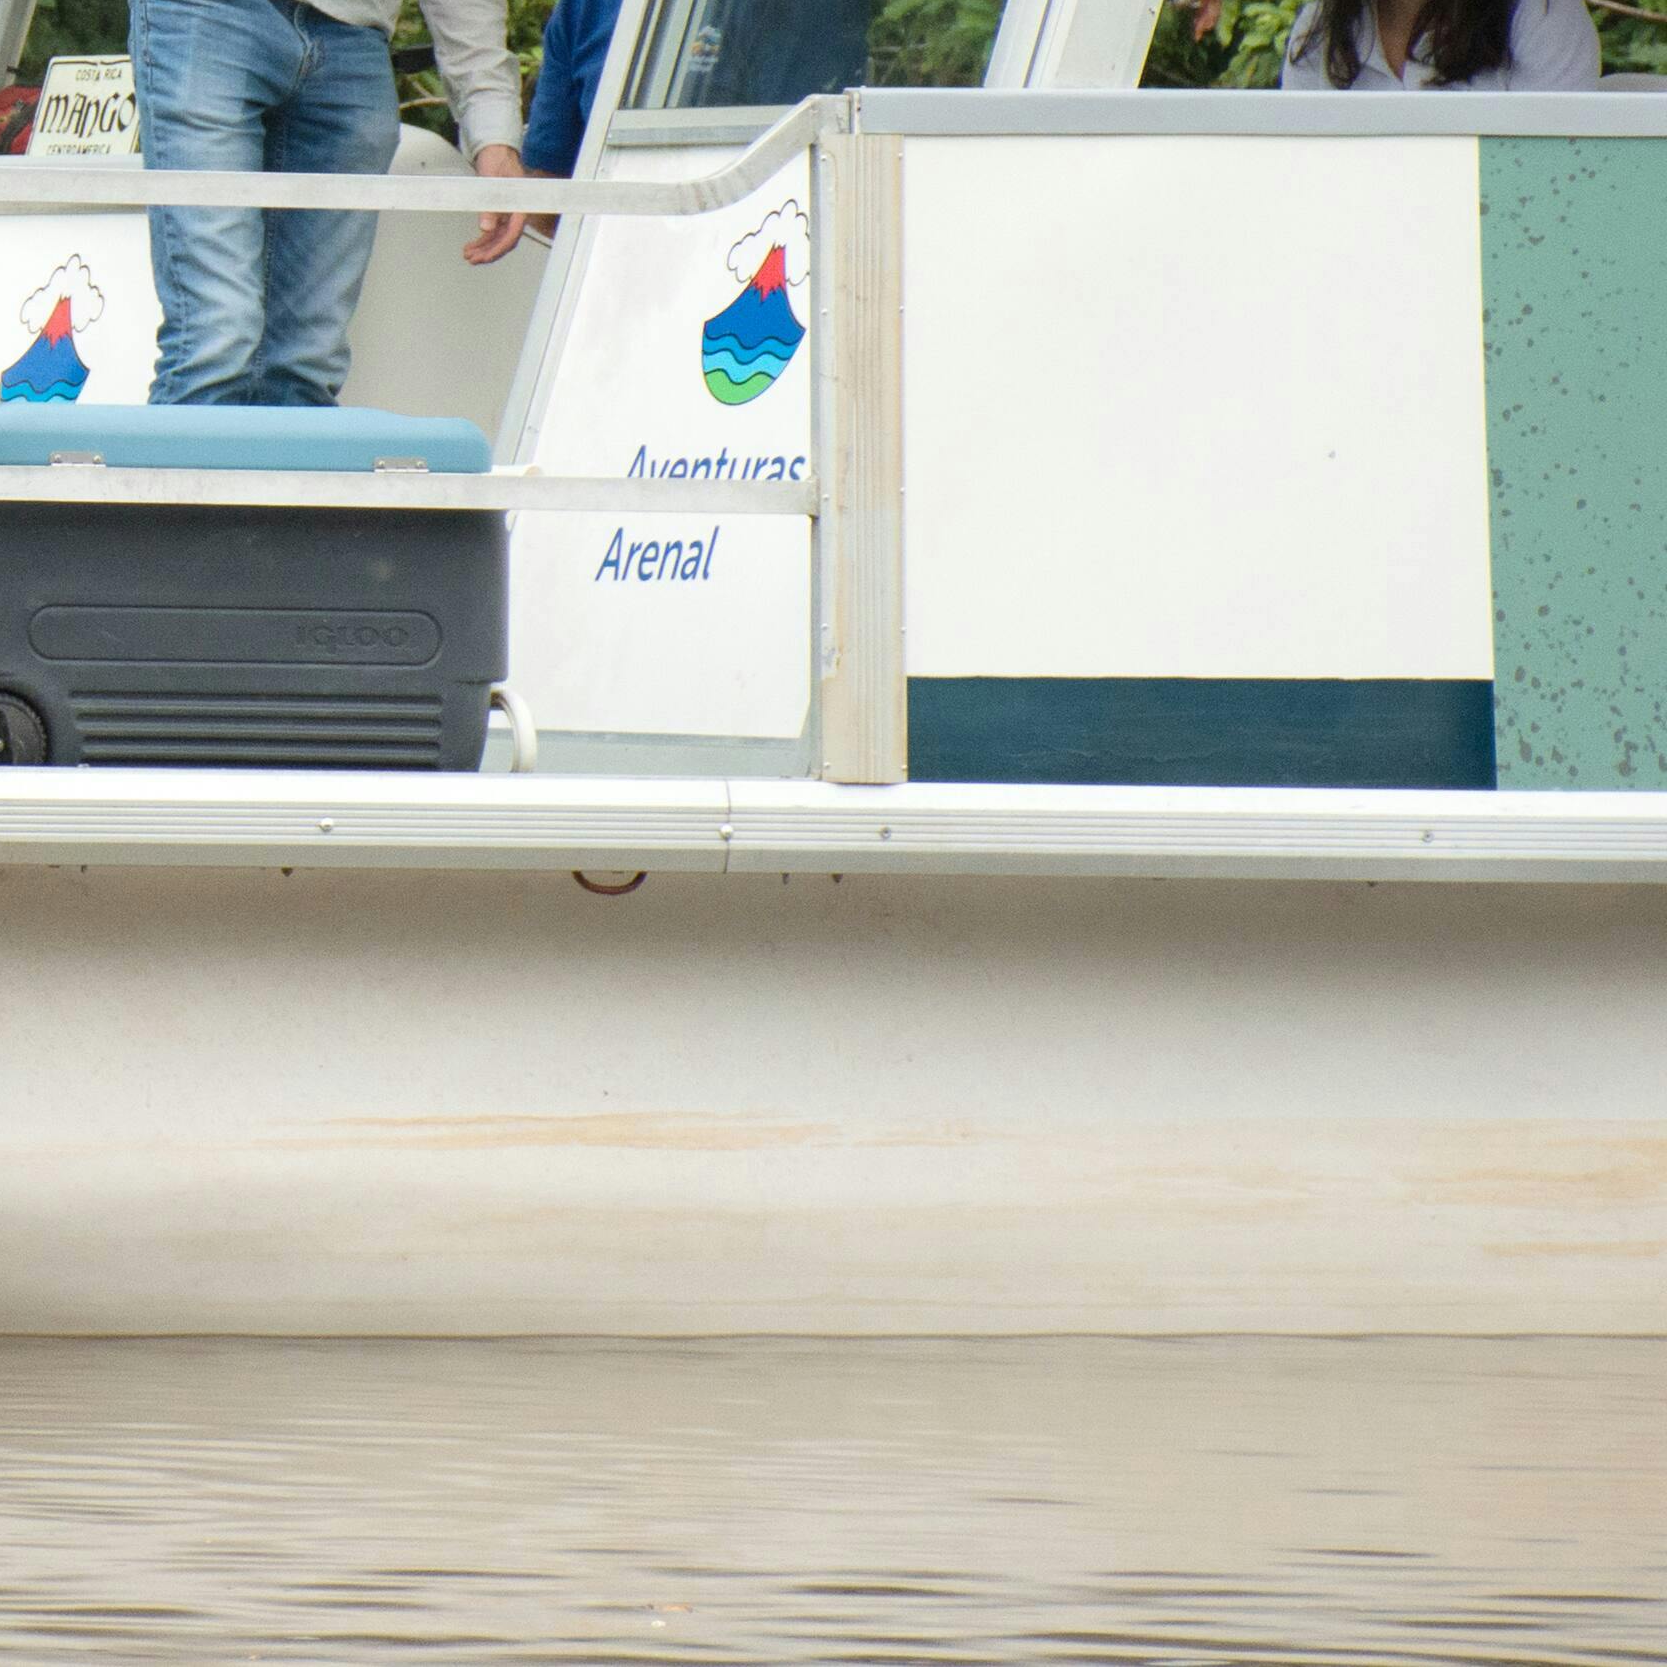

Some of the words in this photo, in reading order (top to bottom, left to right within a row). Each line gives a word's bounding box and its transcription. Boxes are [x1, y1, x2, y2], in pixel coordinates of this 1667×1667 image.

[76, 69, 100, 81] COSTA
[105, 69, 122, 79] RICA
[40, 92, 136, 138] MANGO
[595, 525, 721, 582] Arenal
[294, 625, 411, 653] IGLOO
